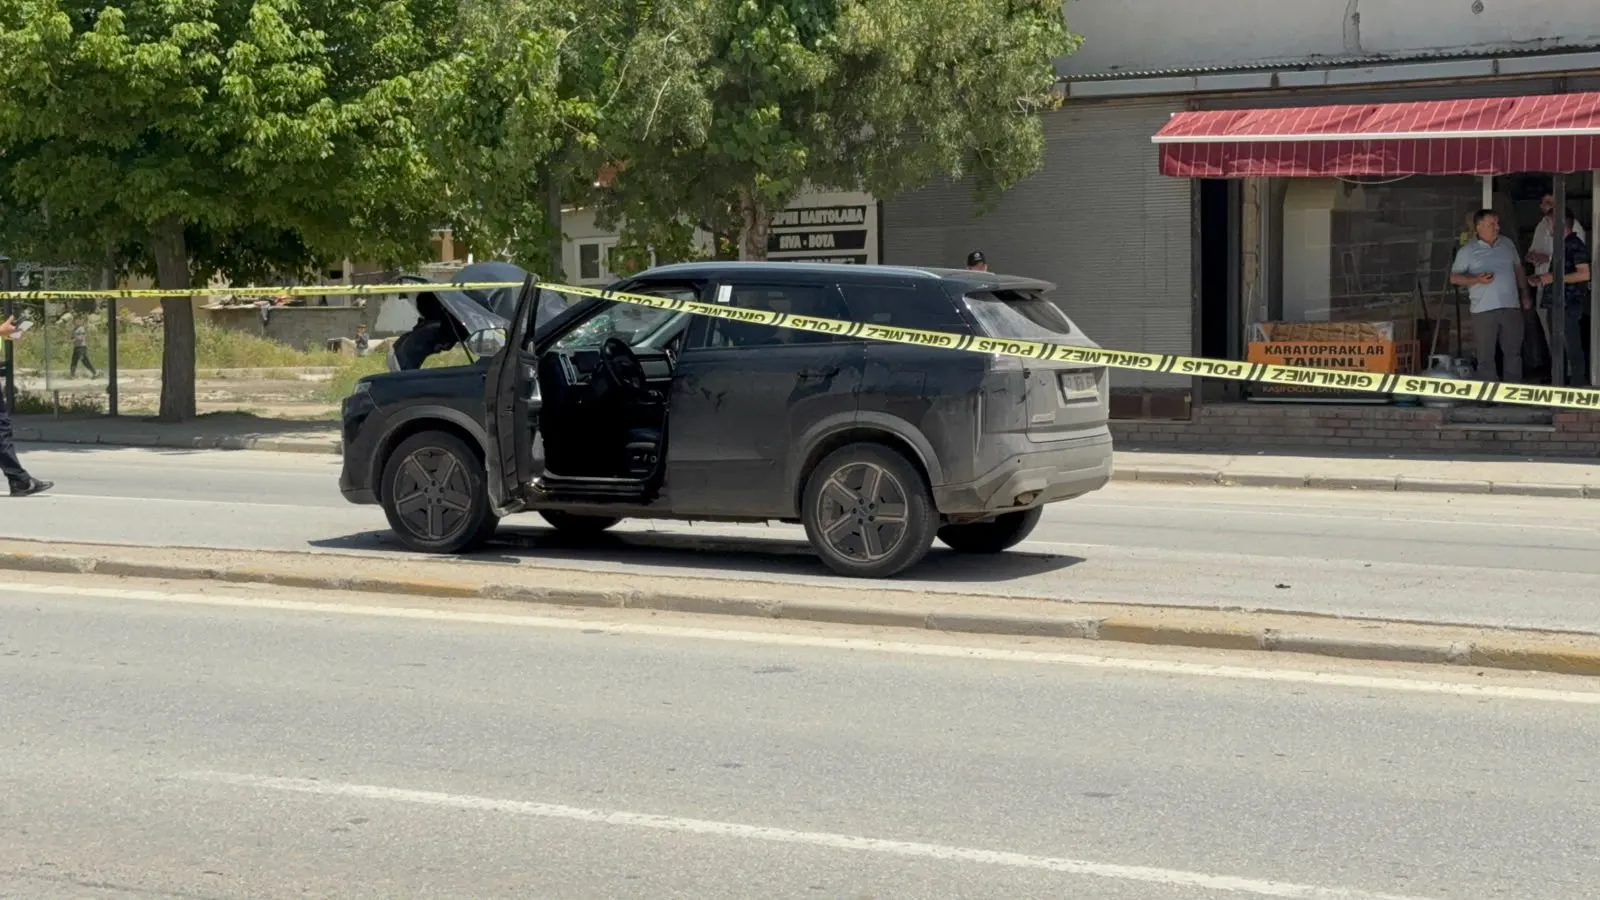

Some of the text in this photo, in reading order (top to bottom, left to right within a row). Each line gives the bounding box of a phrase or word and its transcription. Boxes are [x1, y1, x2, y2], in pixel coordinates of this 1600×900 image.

[1264, 345, 1384, 355] KARATOPRAKLAR
[1182, 360, 1242, 377] POLİS
[1283, 357, 1365, 367] TAHİNLİ
[1270, 368, 1472, 396] POLİS GİRİLMEZ
[1503, 387, 1600, 406] İRİLMEZ
